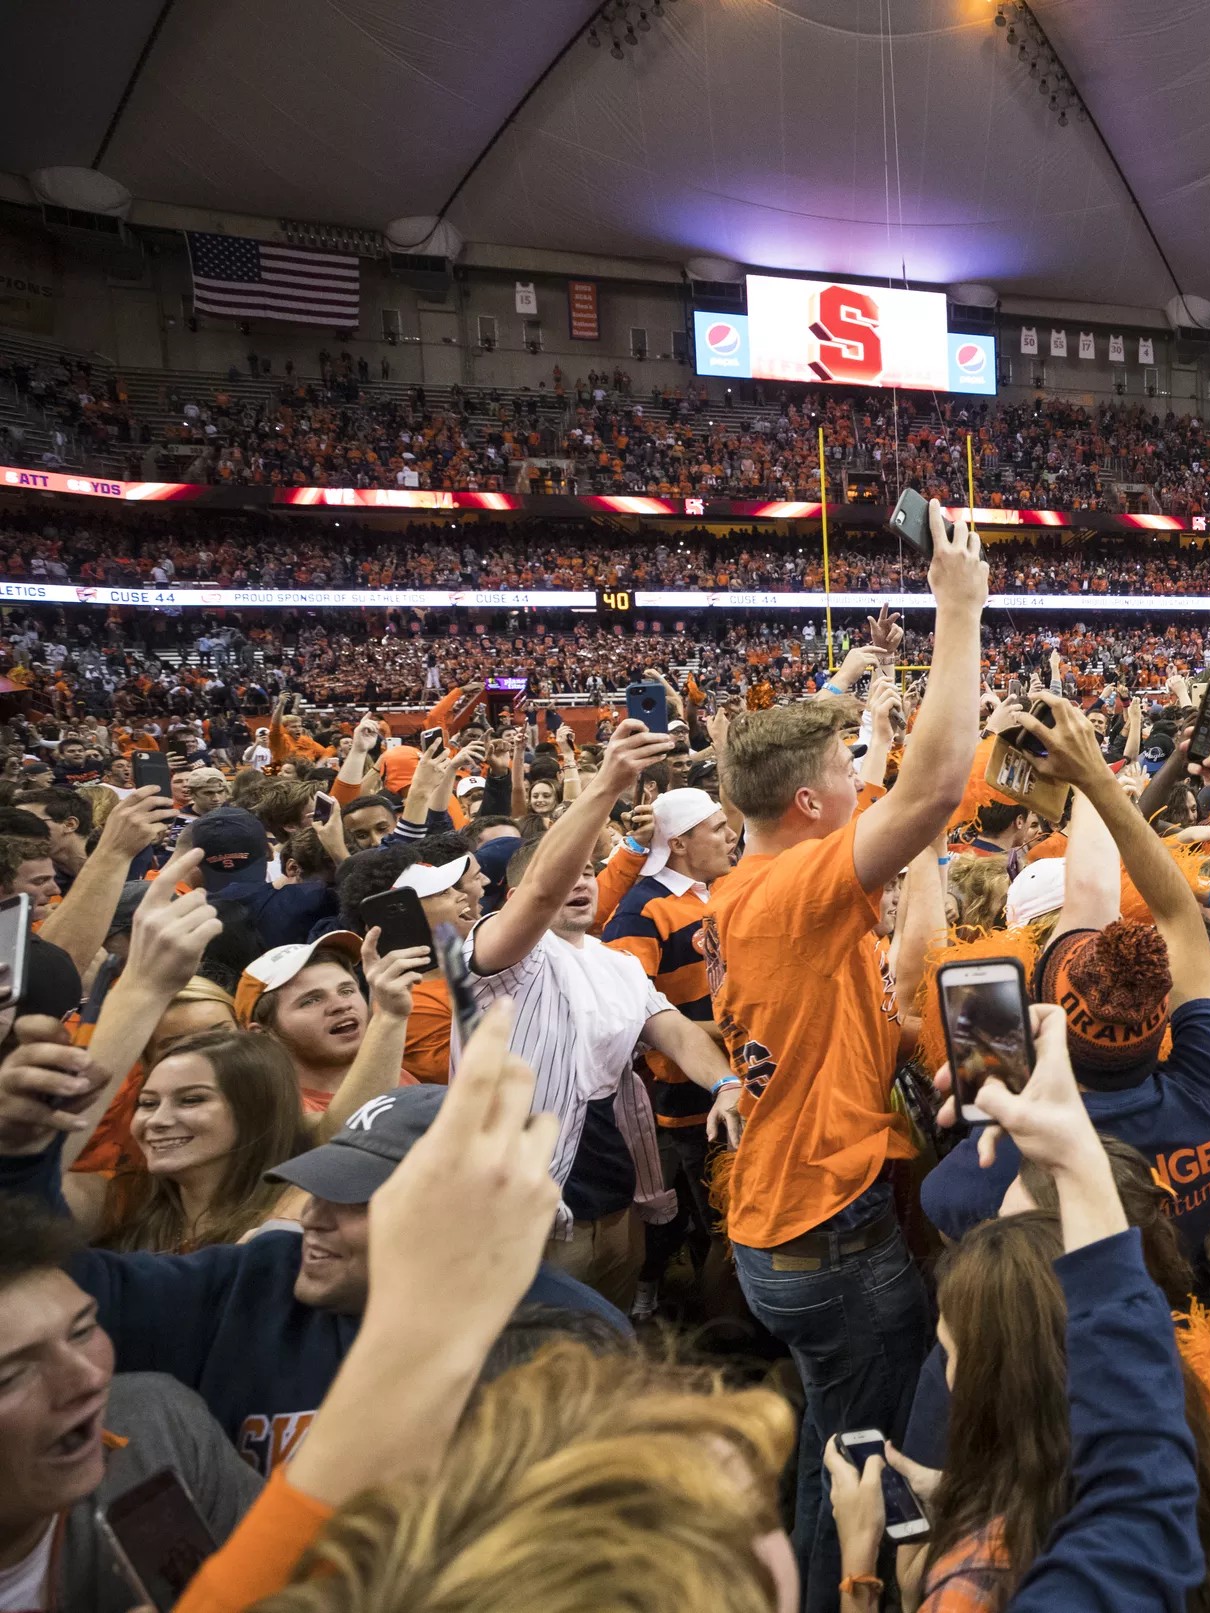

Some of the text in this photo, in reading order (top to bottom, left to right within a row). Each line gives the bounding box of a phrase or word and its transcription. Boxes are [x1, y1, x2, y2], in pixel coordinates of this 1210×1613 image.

[520, 295, 532, 305] 15
[808, 285, 883, 384] S
[1024, 338, 1035, 347] 50
[1082, 343, 1091, 352] 17
[1111, 346, 1122, 354] 30
[20, 473, 48, 487] ATT
[91, 482, 121, 496] YDS
[110, 591, 175, 602] CUSE 44
[235, 594, 272, 603] PROUD
[277, 594, 330, 603] SPONSOR
[334, 595, 346, 603] OF
[370, 595, 426, 603] ATHLETICS
[476, 594, 529, 604] CUSE 44
[603, 592, 629, 610] 40
[730, 595, 777, 604] CUSE 44
[1003, 598, 1044, 606] CUSE 44
[222, 860, 235, 868] S
